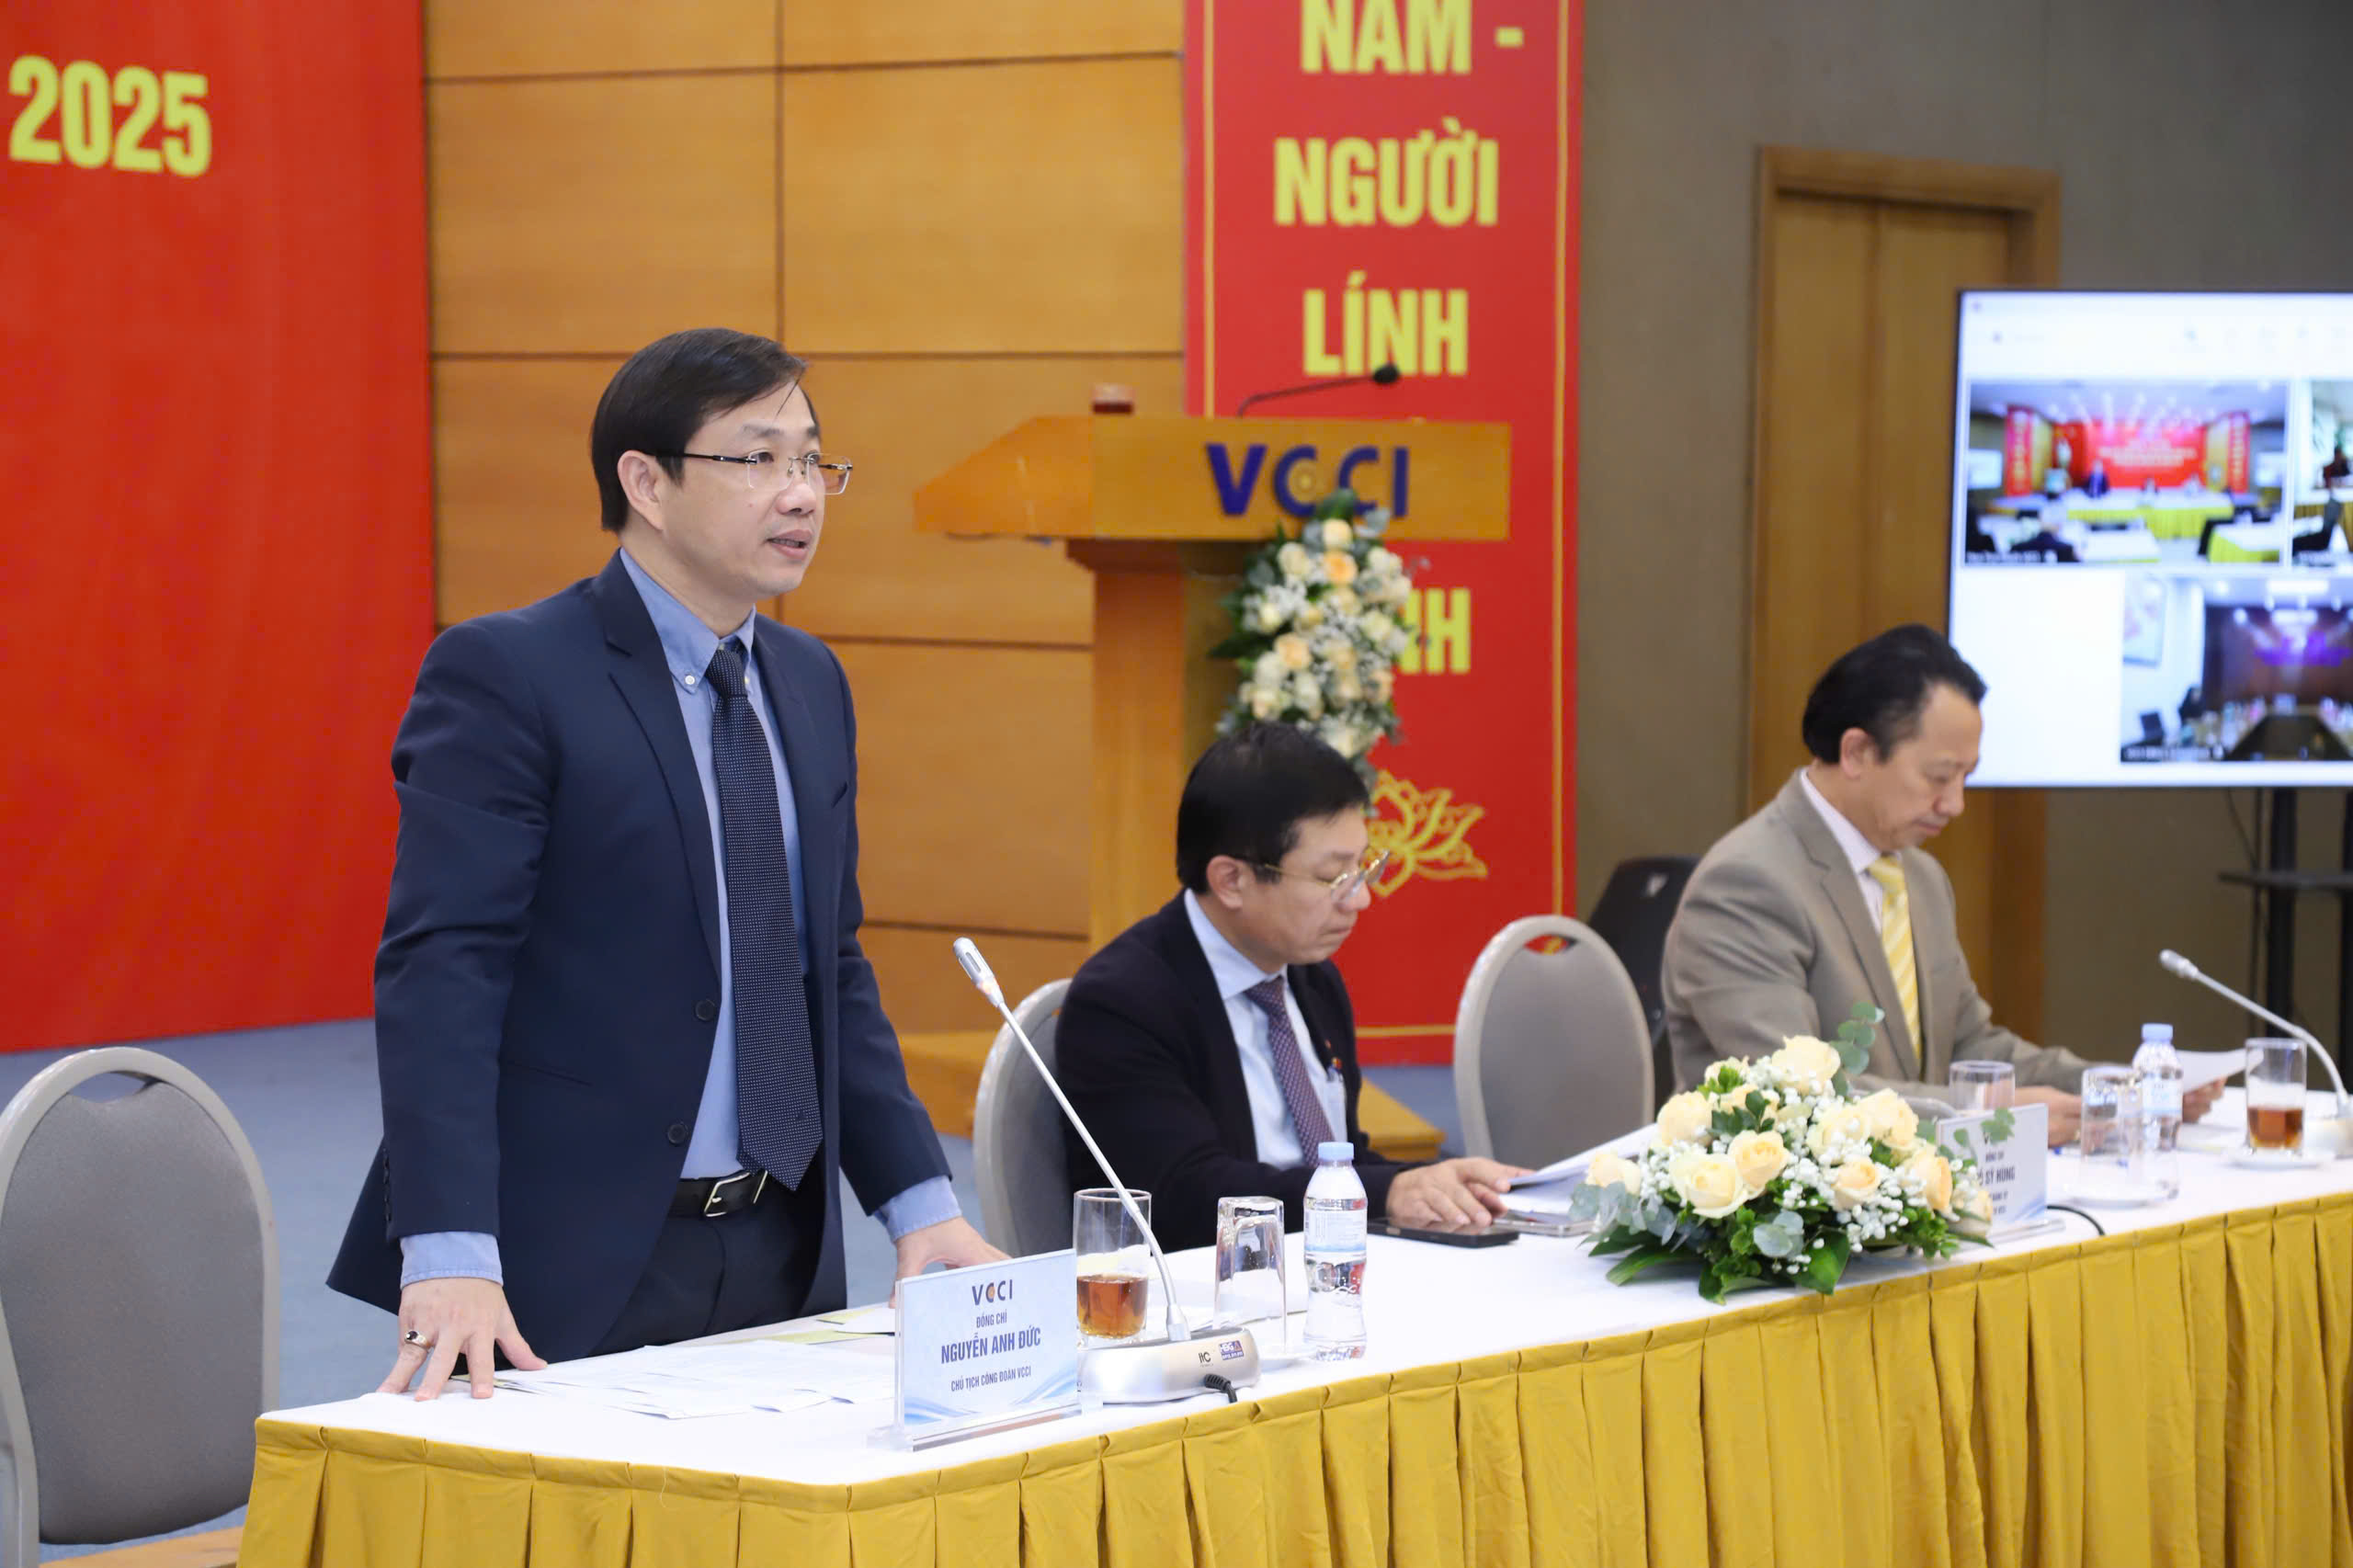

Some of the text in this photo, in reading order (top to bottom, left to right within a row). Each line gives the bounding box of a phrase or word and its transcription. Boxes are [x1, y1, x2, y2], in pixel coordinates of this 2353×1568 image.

[1301, 0, 1473, 74] NAM
[7, 54, 213, 178] 2025
[1273, 116, 1500, 228] NGƯỜI
[1302, 269, 1470, 378] LÍNH
[1204, 442, 1411, 518] VCCI
[972, 1278, 1013, 1306] VCCI
[976, 1310, 1007, 1328] ĐỒNG CHÍ
[940, 1324, 1041, 1364] NGUYỄN ANH ĐỨC
[950, 1366, 1031, 1392] CHỦ TỊCH CÔNG ĐOÀN VCCI
